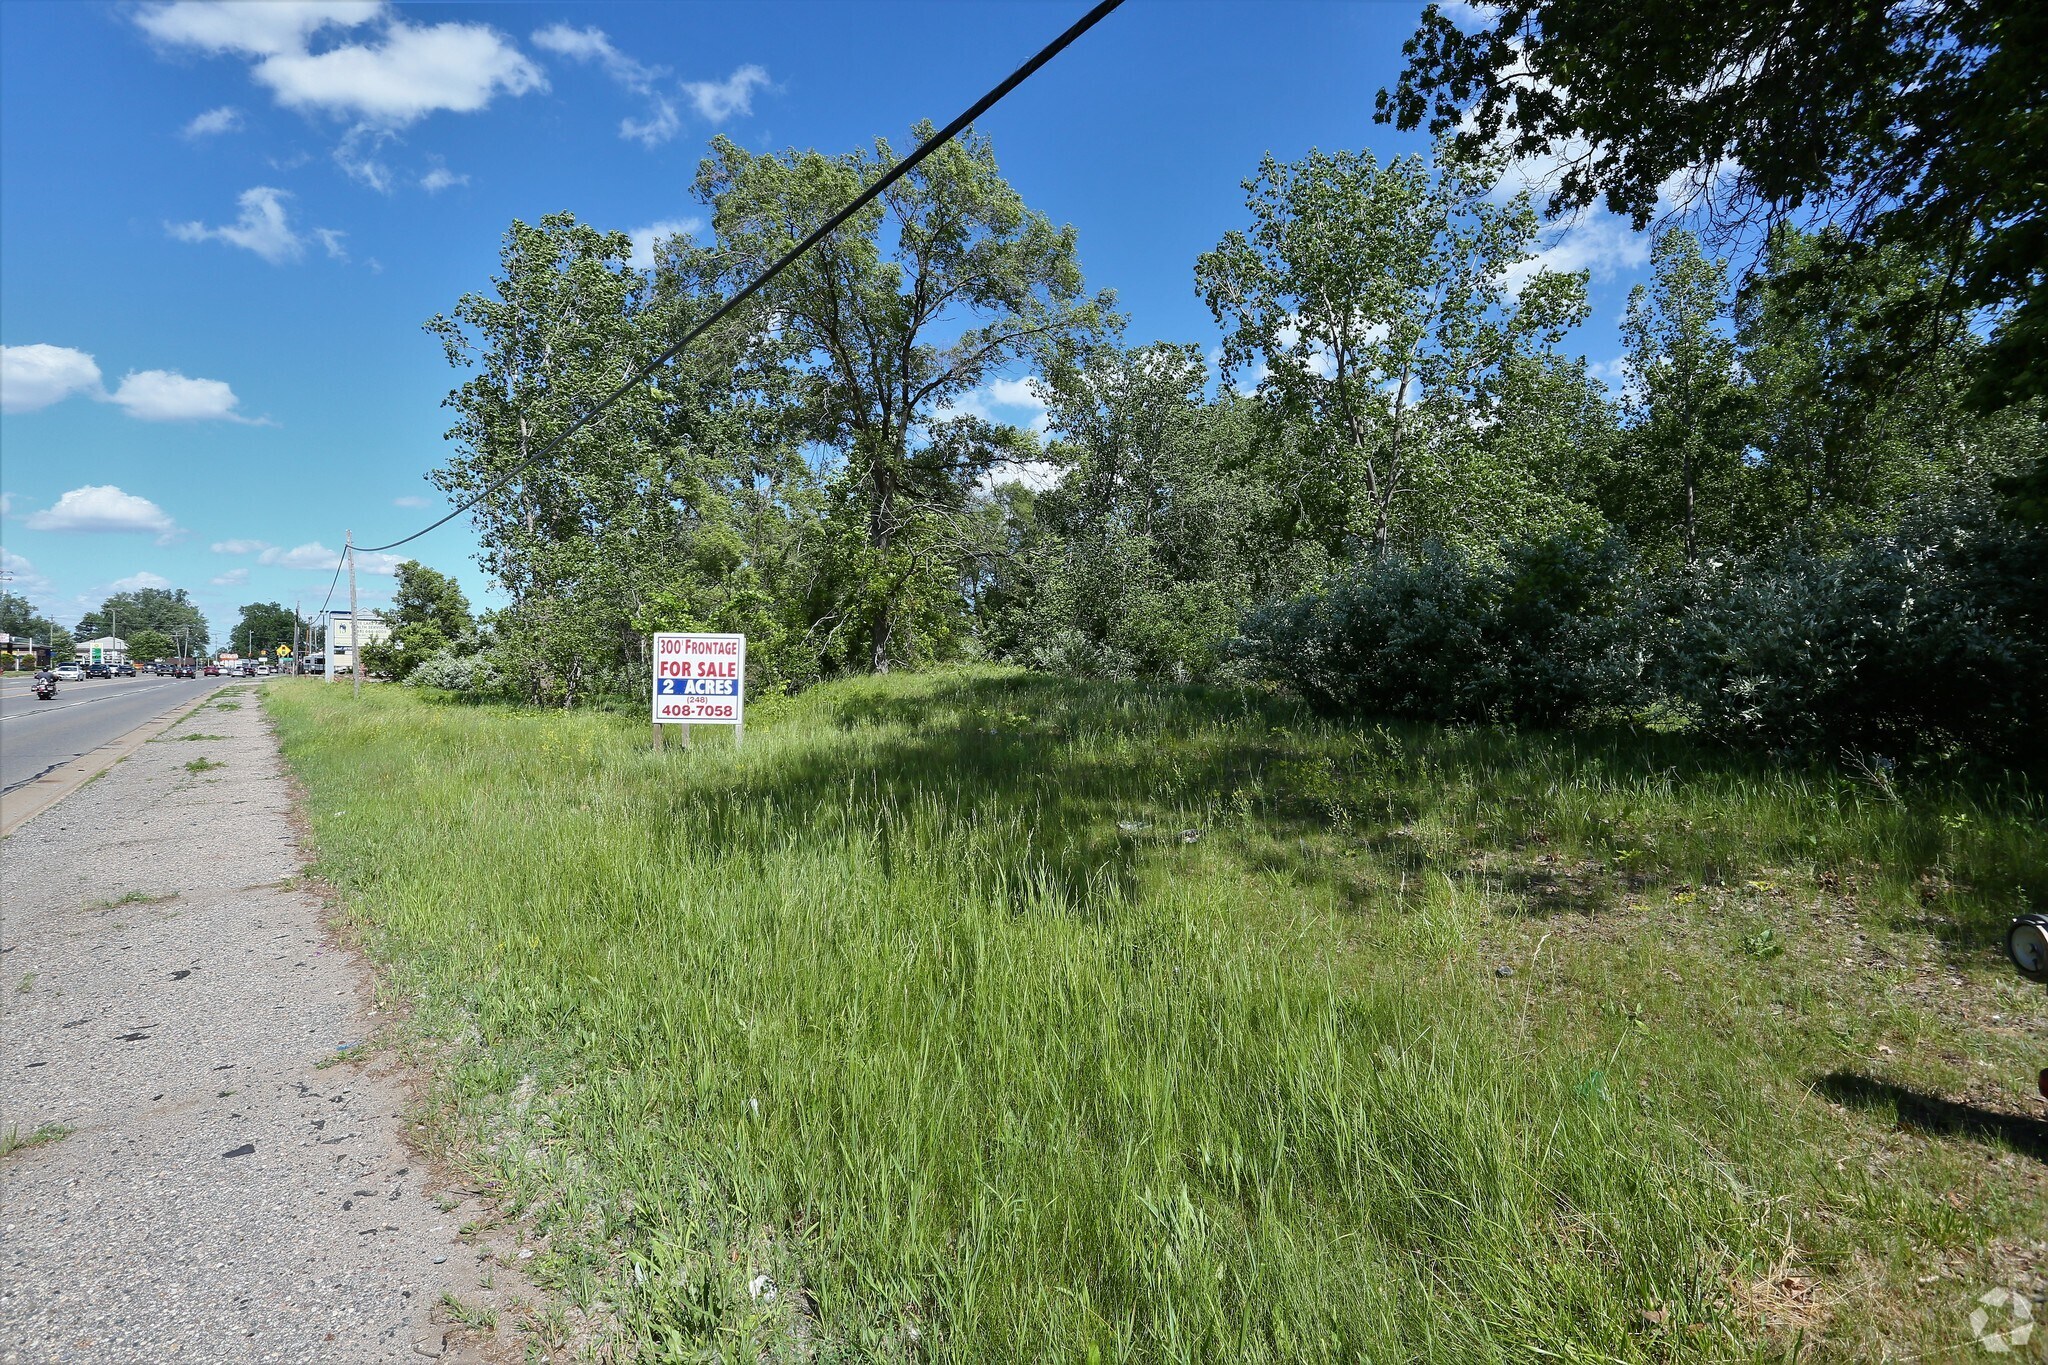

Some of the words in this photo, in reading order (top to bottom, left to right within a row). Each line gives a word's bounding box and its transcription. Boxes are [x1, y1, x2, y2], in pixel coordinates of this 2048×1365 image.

[660, 639, 684, 654] 300'
[685, 639, 737, 655] FRONTAGE
[660, 661, 691, 677] FOR
[697, 661, 736, 677] SALE
[662, 679, 674, 694] 2
[684, 679, 733, 695] ACRES
[686, 696, 708, 704] (248)
[661, 704, 733, 717] 408-7058
